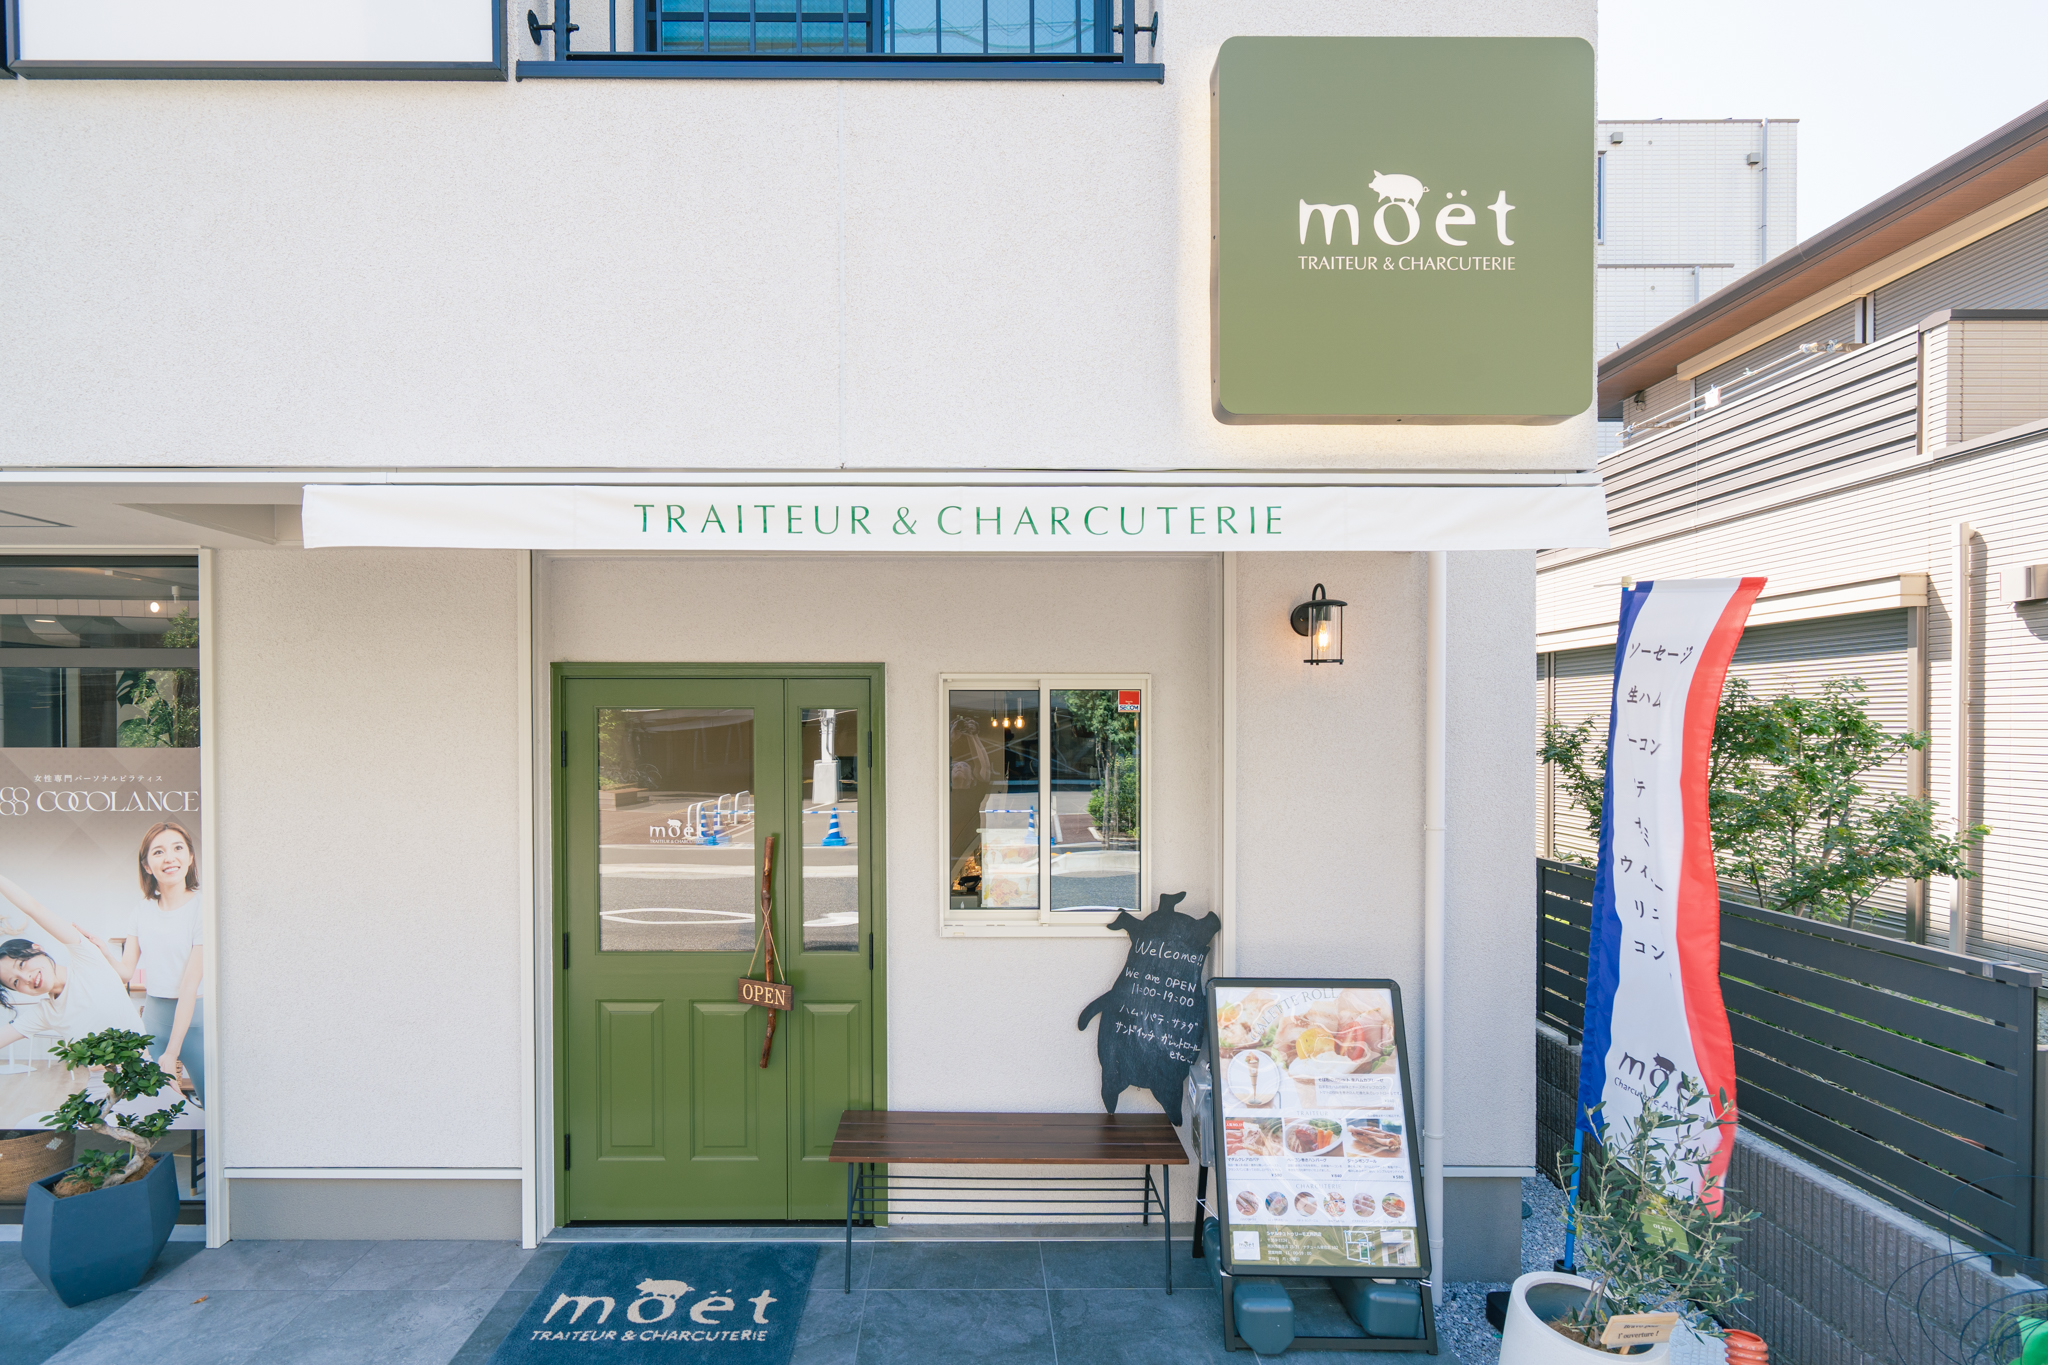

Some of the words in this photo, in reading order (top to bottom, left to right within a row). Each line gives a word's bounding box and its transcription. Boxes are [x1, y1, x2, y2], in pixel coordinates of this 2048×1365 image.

[1299, 189, 1516, 246] moët
[1298, 256, 1378, 270] TRAITEUR
[1383, 256, 1395, 270] &
[1399, 256, 1516, 271] CHARCUTERIE
[633, 503, 872, 535] TRAITEUR
[891, 504, 919, 536] &
[936, 504, 1283, 536] CHARCUTERIE
[1629, 643, 1694, 665] ソーセージ
[1627, 685, 1661, 708] 生ハム
[36, 790, 200, 812] COCOLANCE
[1134, 937, 1204, 967] Welcome!!
[1125, 967, 1140, 979] We
[1144, 973, 1160, 984] are
[1165, 977, 1197, 993] OPEN
[742, 983, 786, 1006] OPEN
[1131, 982, 1194, 1008] 11:00-19:00
[1302, 987, 1339, 1003] ROLL
[1652, 1223, 1674, 1233] OLIVE
[543, 1288, 778, 1325] moët
[530, 1329, 618, 1342] TRAITEUR
[620, 1330, 637, 1342] &
[639, 1329, 768, 1342] CHARCUTERIE
